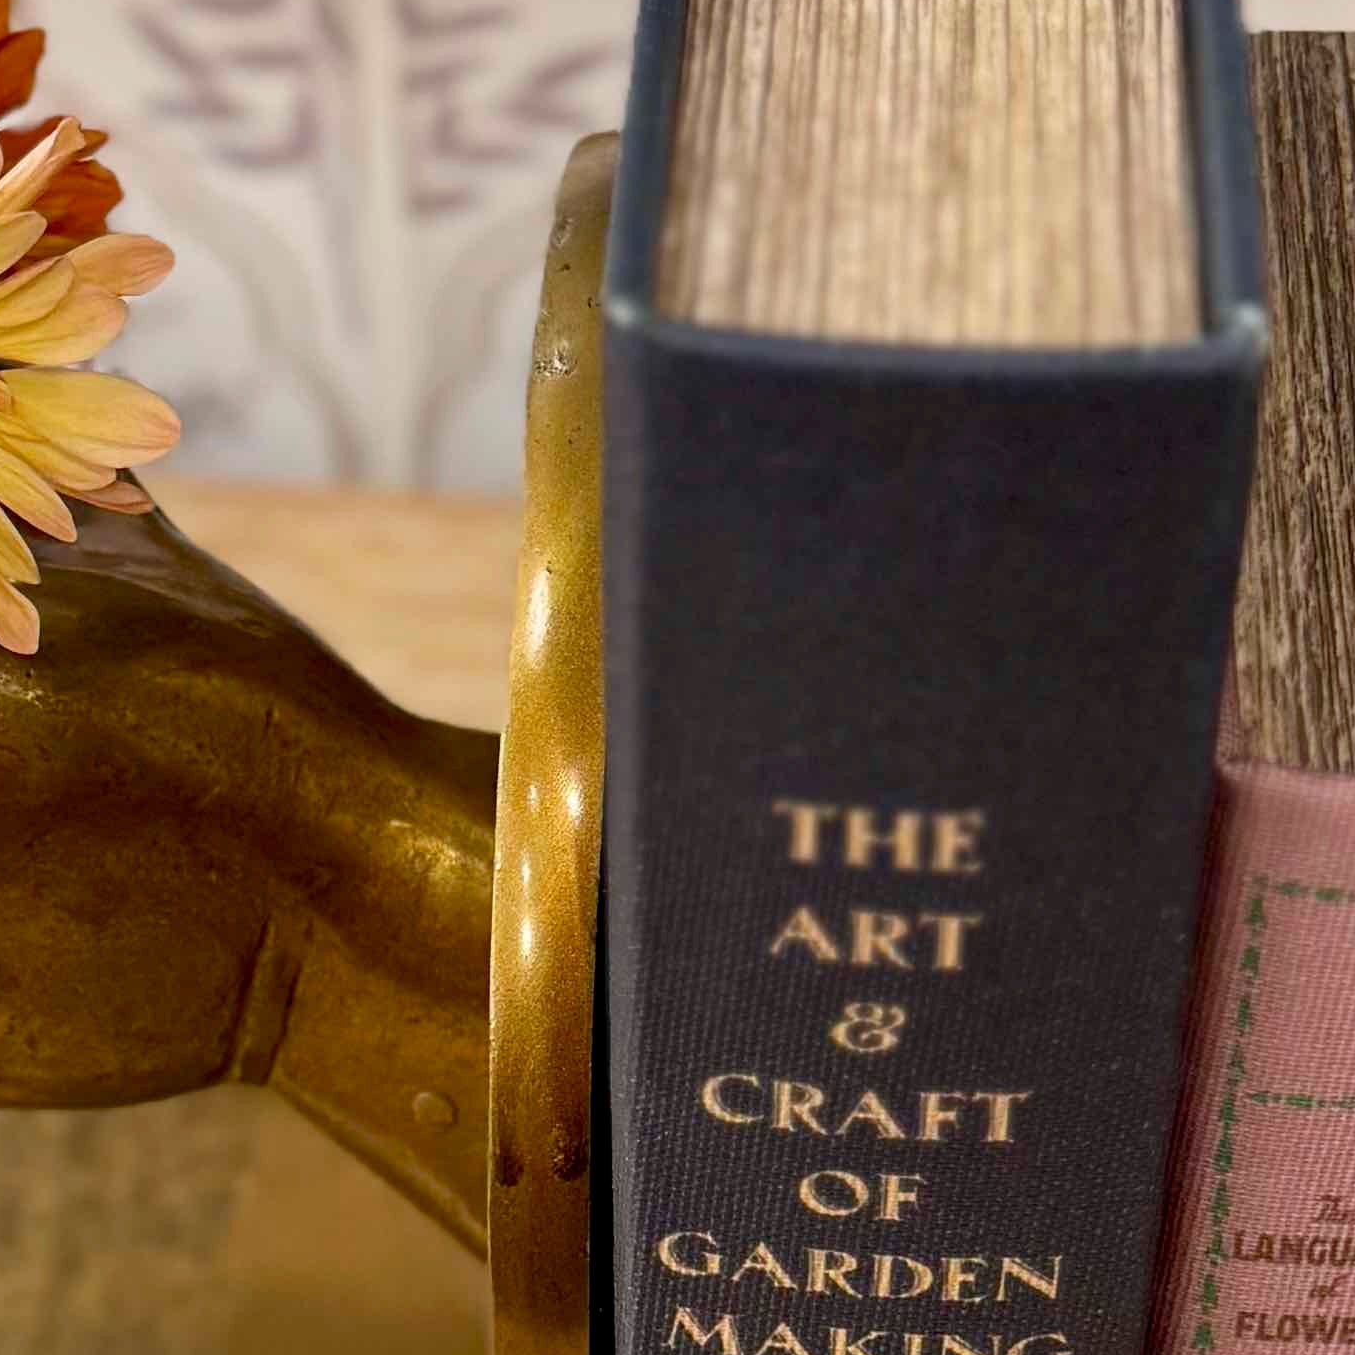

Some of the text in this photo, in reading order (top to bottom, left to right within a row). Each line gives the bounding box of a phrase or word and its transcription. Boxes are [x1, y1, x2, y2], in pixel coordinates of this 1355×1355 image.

[774, 799, 985, 874] THE
[770, 906, 982, 971] ART
[829, 1002, 906, 1052] &
[699, 1073, 1033, 1143] CRAFT
[799, 1170, 926, 1221] OF
[657, 1231, 1063, 1302] GARDEN
